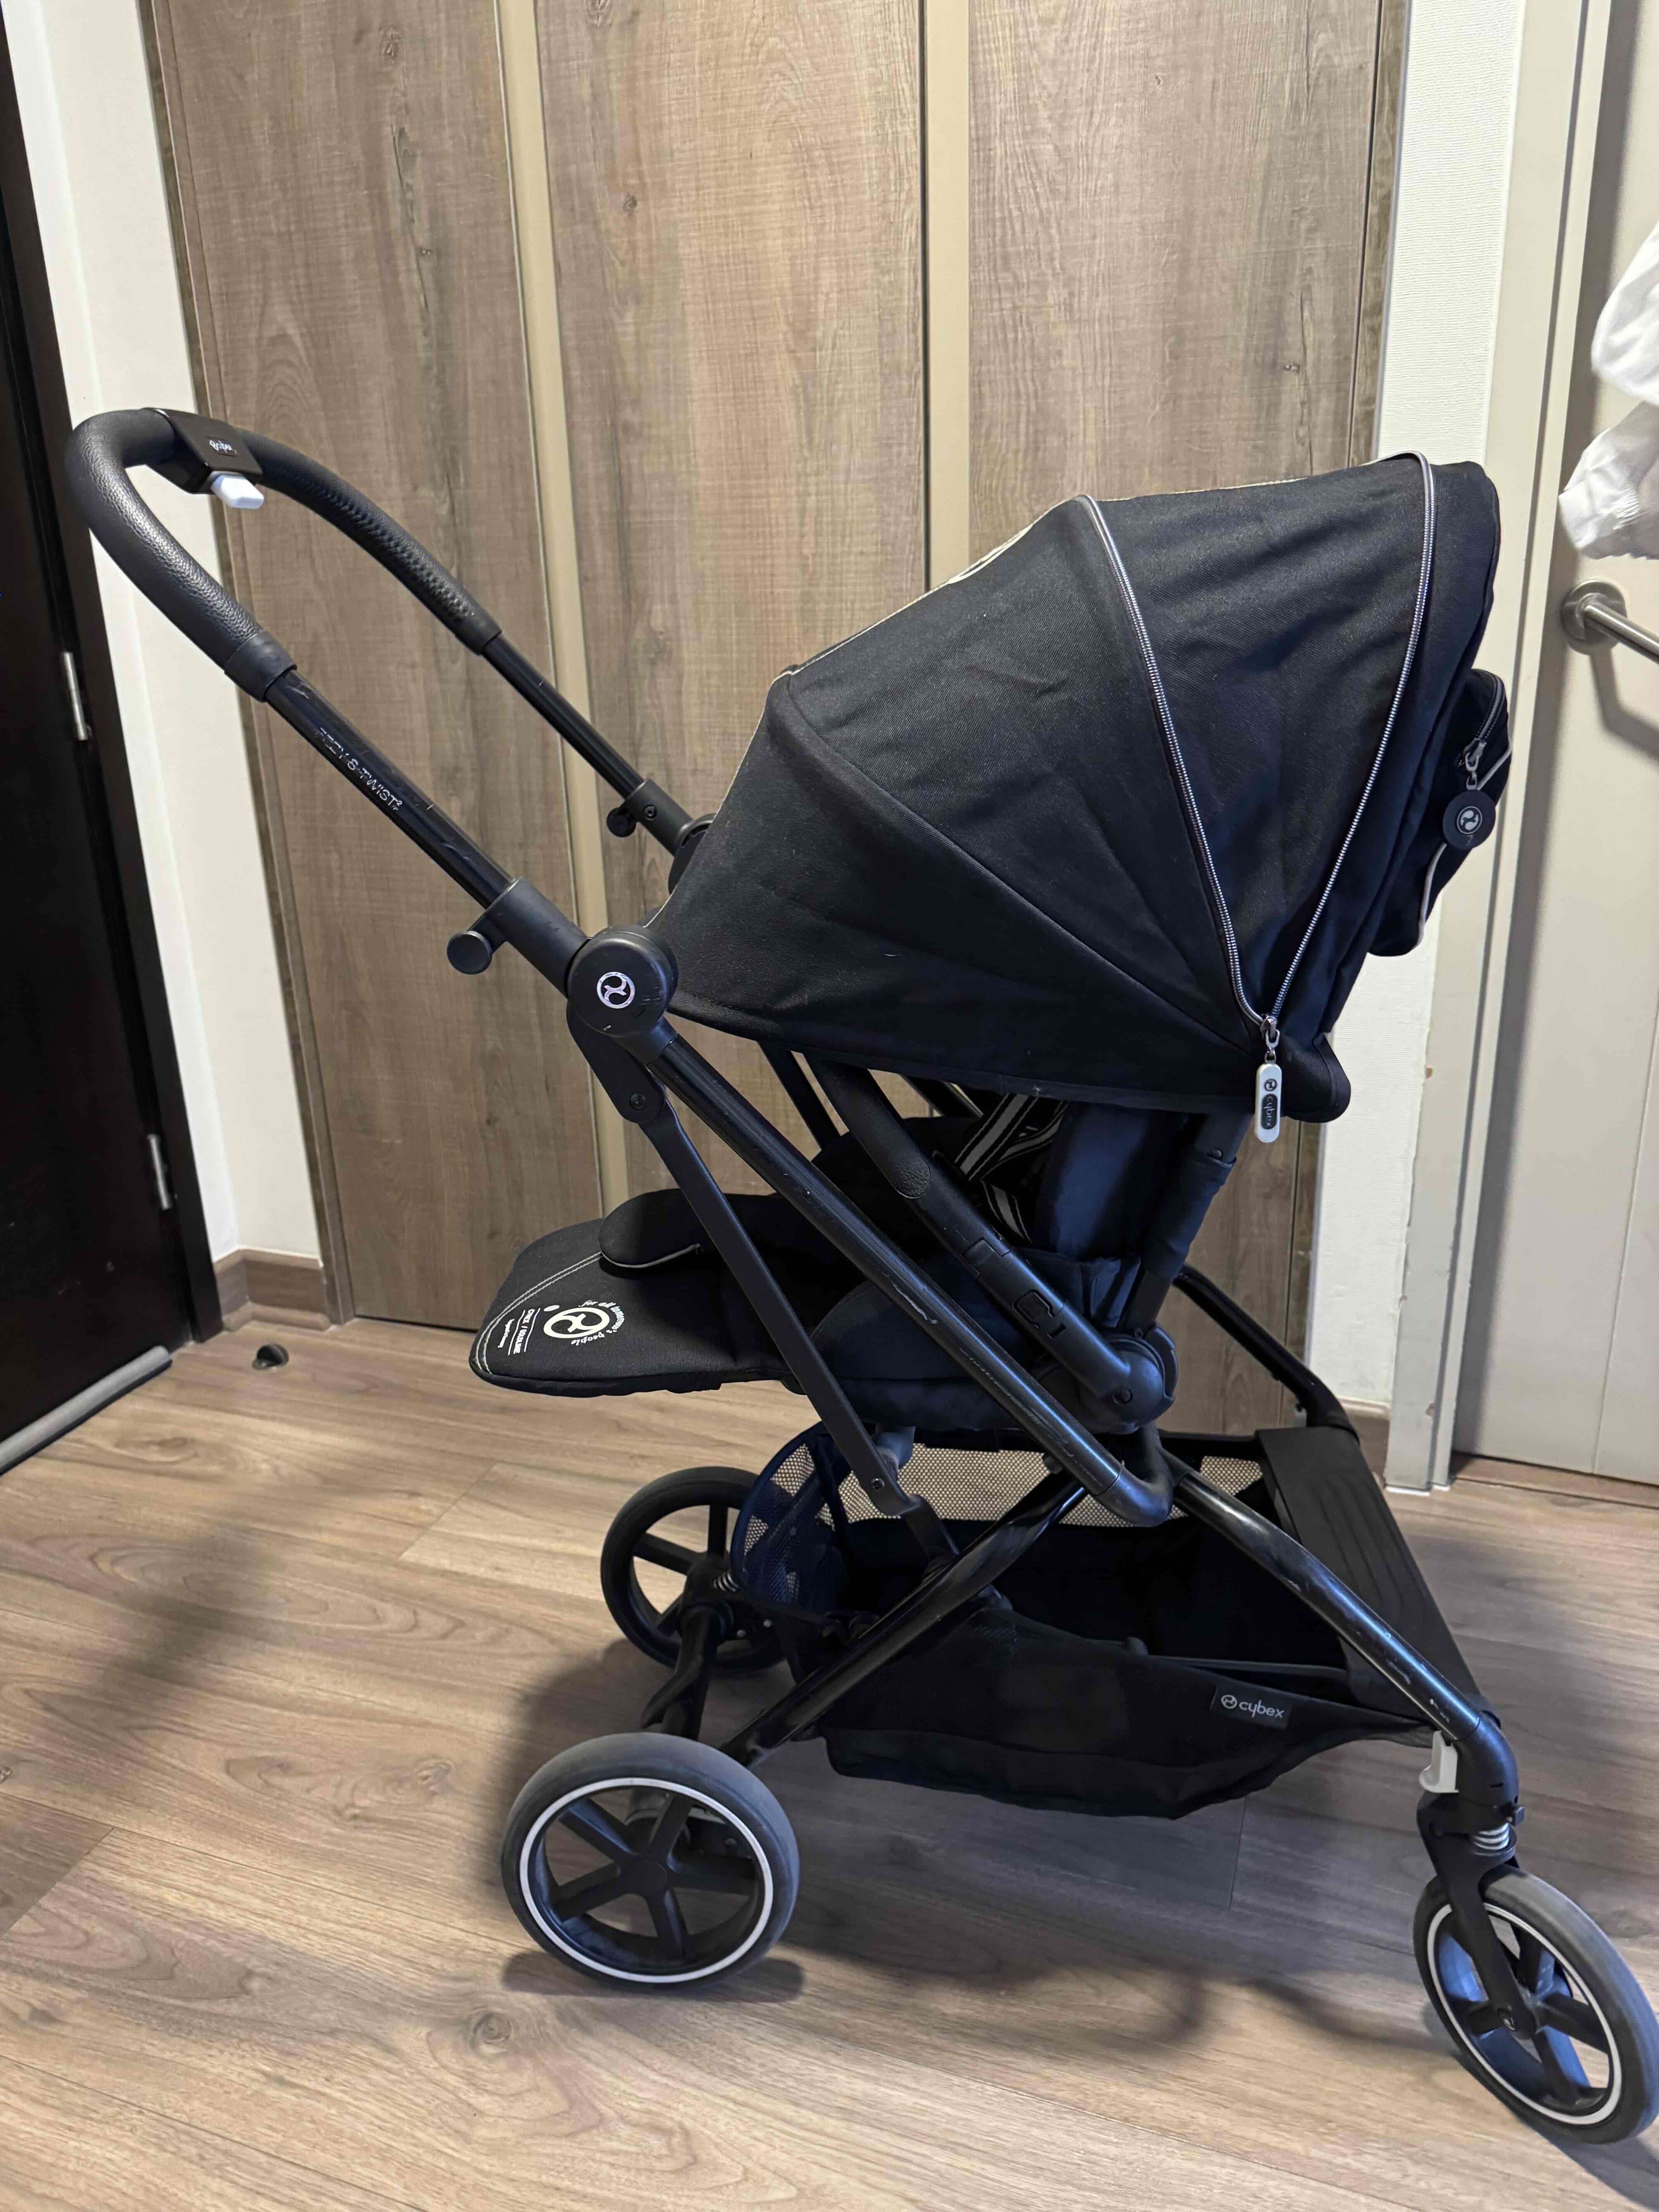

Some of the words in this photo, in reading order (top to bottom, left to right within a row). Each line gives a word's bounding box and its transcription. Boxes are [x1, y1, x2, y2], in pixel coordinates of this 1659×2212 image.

[1263, 1096, 1275, 1127] cybex
[571, 1331, 605, 1346] people
[1239, 1700, 1285, 1719] cybex
